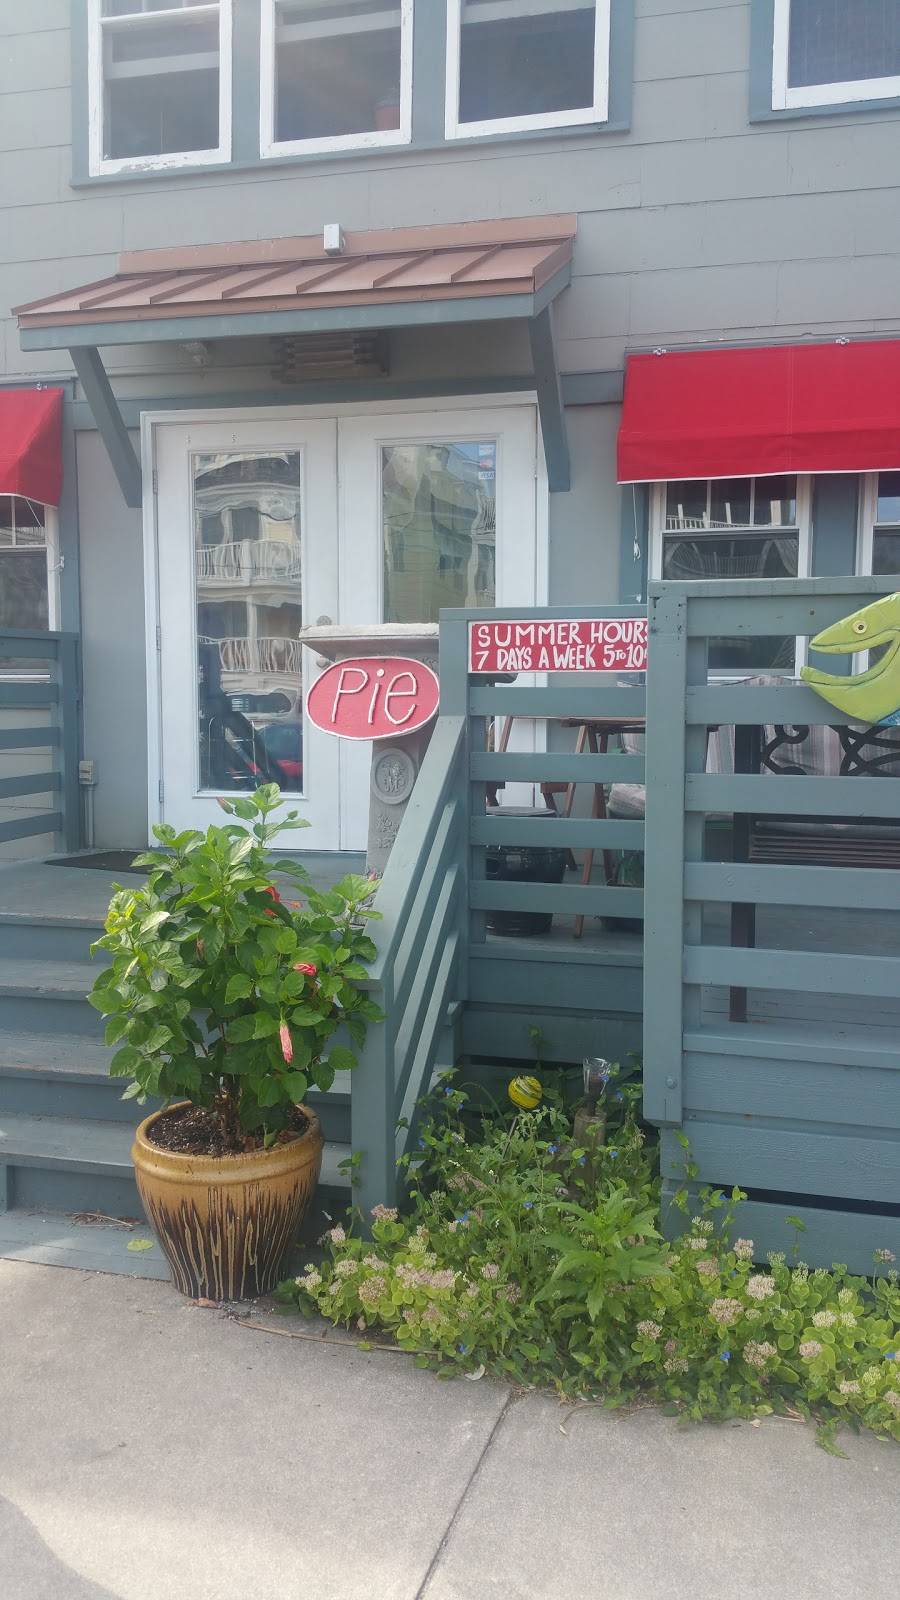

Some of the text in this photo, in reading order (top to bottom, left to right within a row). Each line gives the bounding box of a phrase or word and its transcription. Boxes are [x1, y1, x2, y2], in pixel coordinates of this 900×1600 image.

[478, 624, 582, 647] SUMMER
[475, 650, 489, 670] 7
[497, 646, 532, 670] DAYS
[538, 646, 550, 668] A
[553, 644, 596, 670] WEEK
[332, 667, 417, 725] Pie
